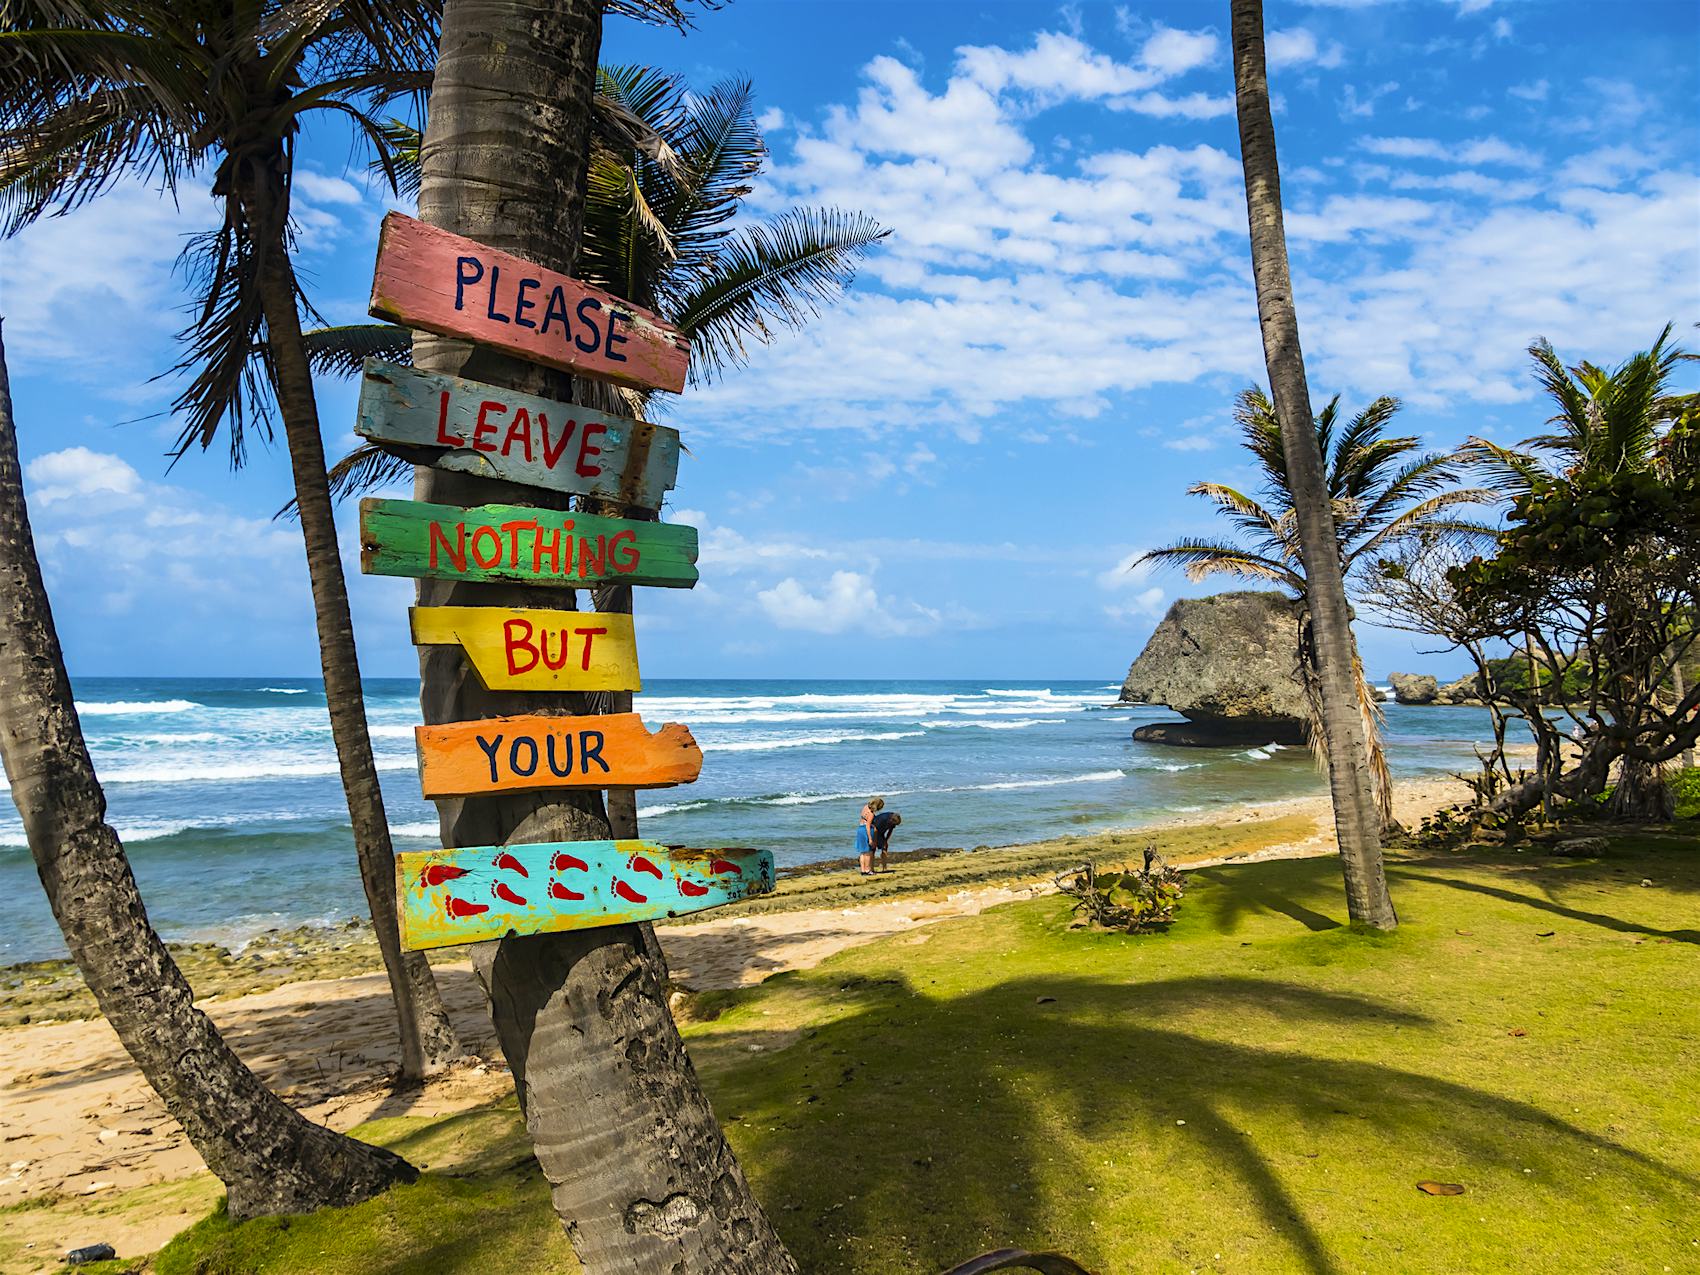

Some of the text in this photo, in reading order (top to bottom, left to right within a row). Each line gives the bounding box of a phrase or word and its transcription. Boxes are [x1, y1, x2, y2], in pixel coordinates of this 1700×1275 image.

[455, 256, 631, 362] PLEASE
[436, 391, 608, 477] LEAVE
[503, 618, 608, 676] BUT
[476, 730, 610, 783] YOUR
